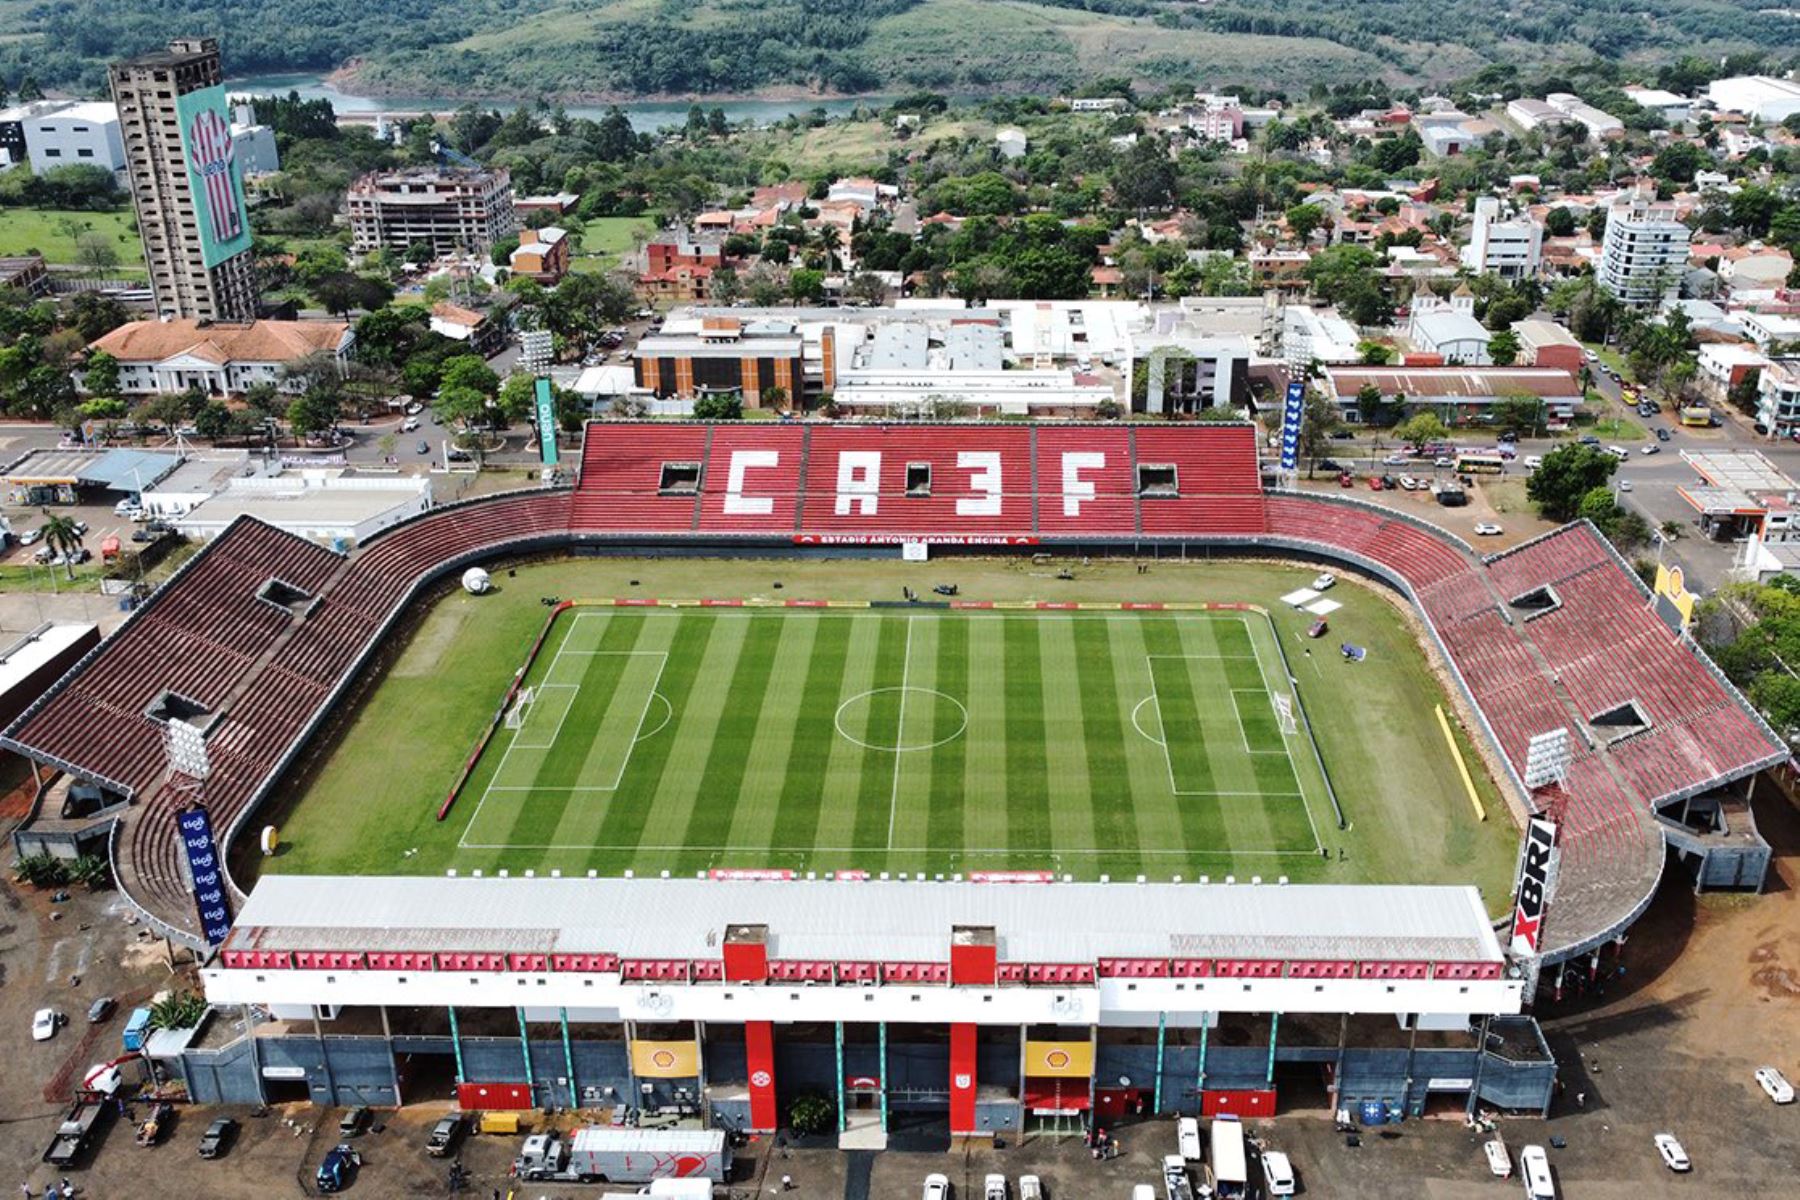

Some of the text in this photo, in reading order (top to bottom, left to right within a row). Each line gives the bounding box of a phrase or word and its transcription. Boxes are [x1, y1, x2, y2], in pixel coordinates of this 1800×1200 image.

[540, 403, 554, 442] ueno
[820, 535, 1009, 545] ESTADIO ANTONIO ARANDA ENCINA
[1515, 824, 1553, 951] XBRI
